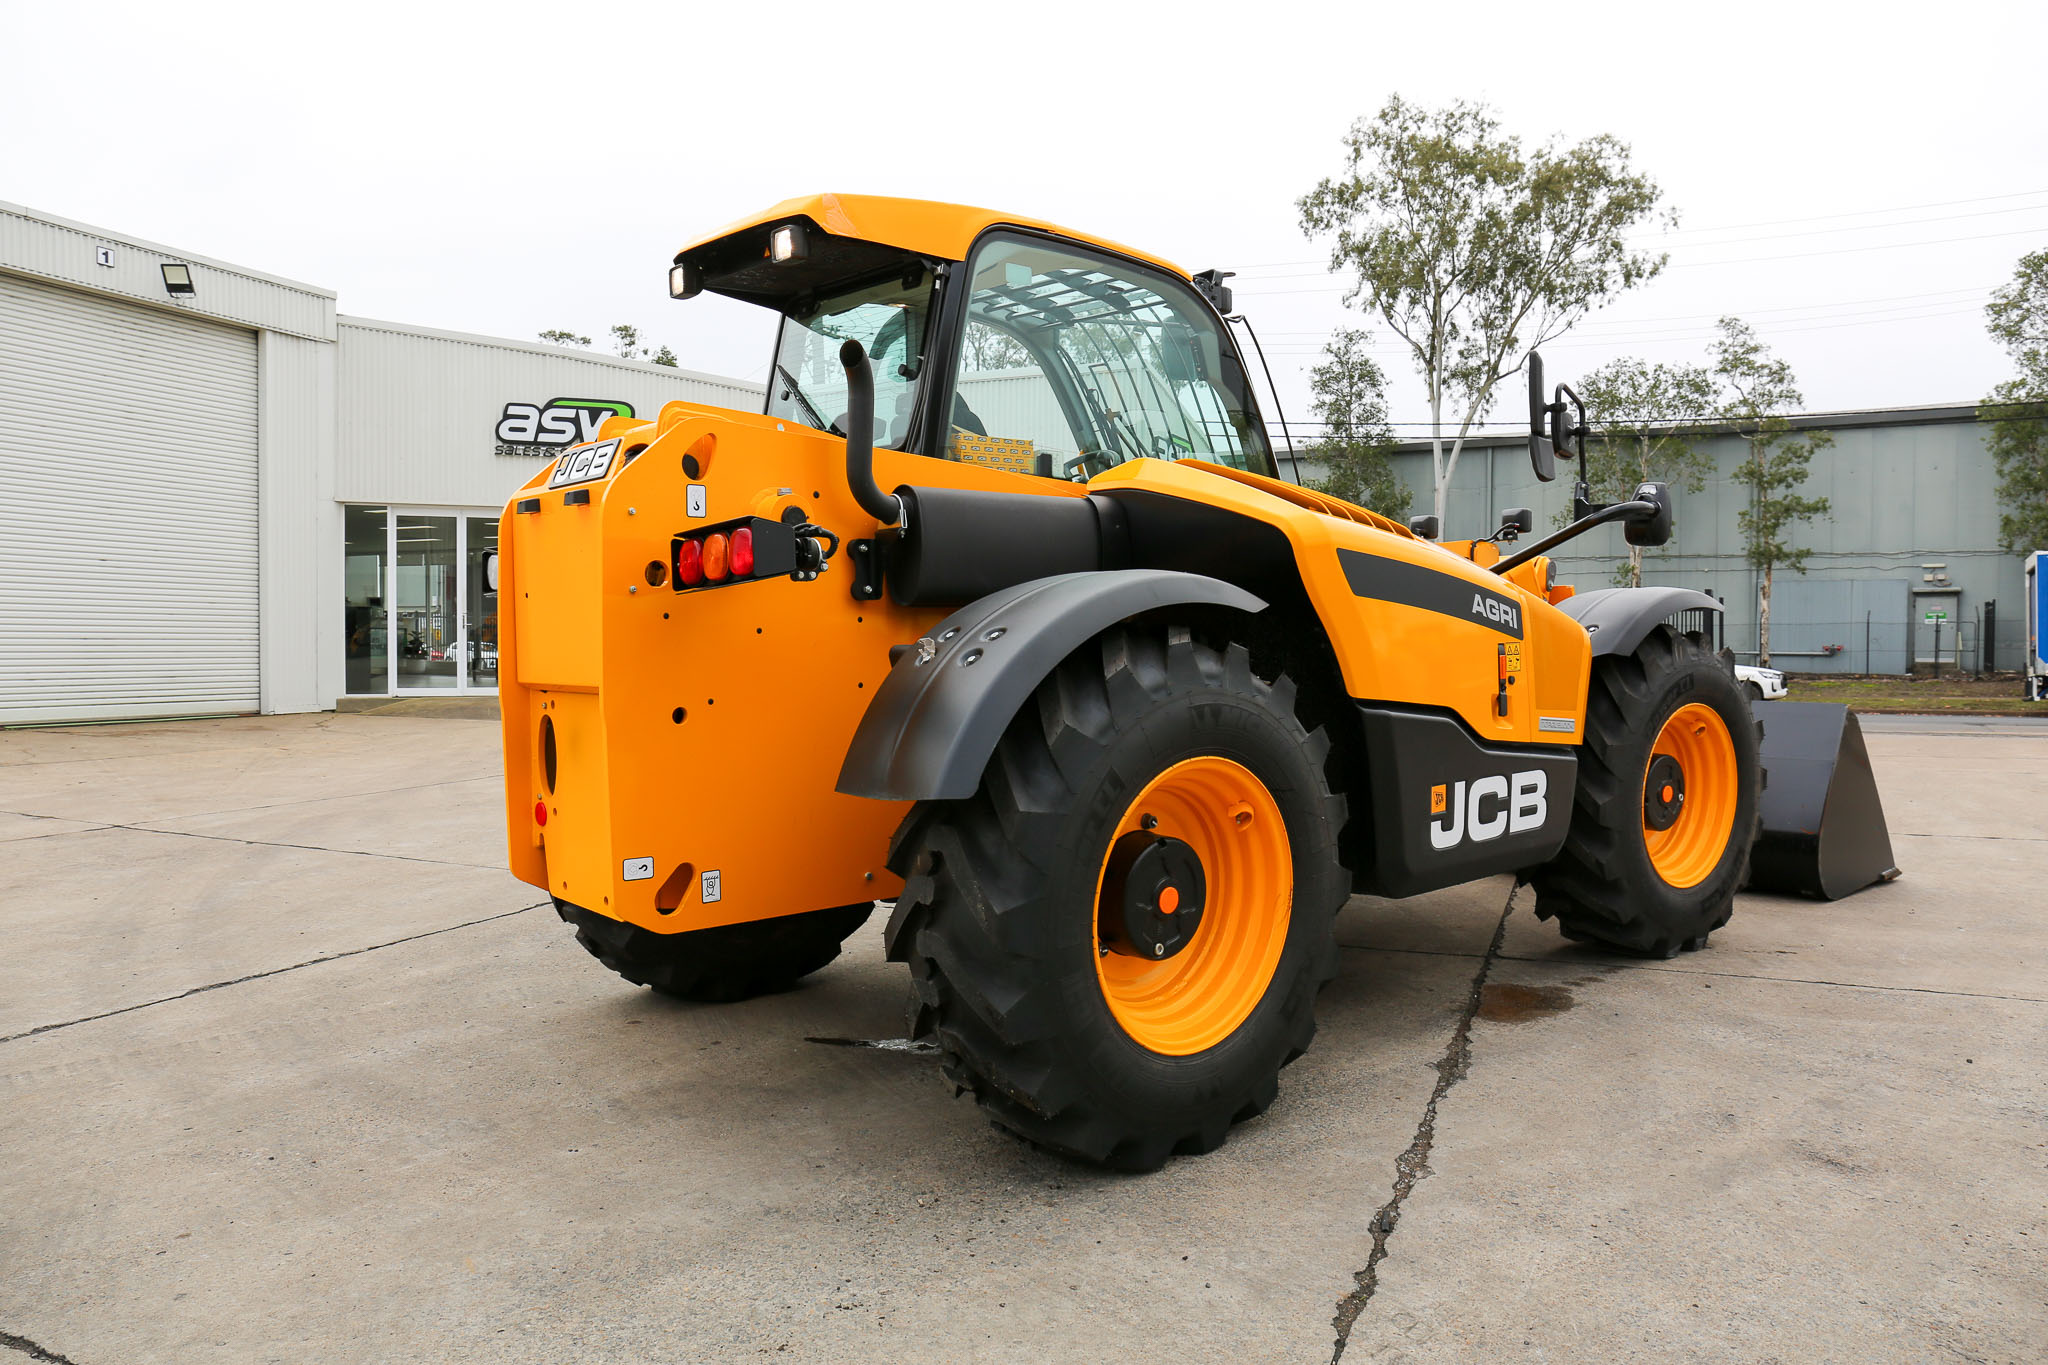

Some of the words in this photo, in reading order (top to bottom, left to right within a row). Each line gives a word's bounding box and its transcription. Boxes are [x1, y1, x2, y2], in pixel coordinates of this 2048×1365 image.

[102, 250, 109, 264] 1
[543, 447, 557, 457] &
[552, 443, 615, 484] JCB
[1471, 593, 1518, 630] AGRI
[1431, 769, 1547, 850] JCB
